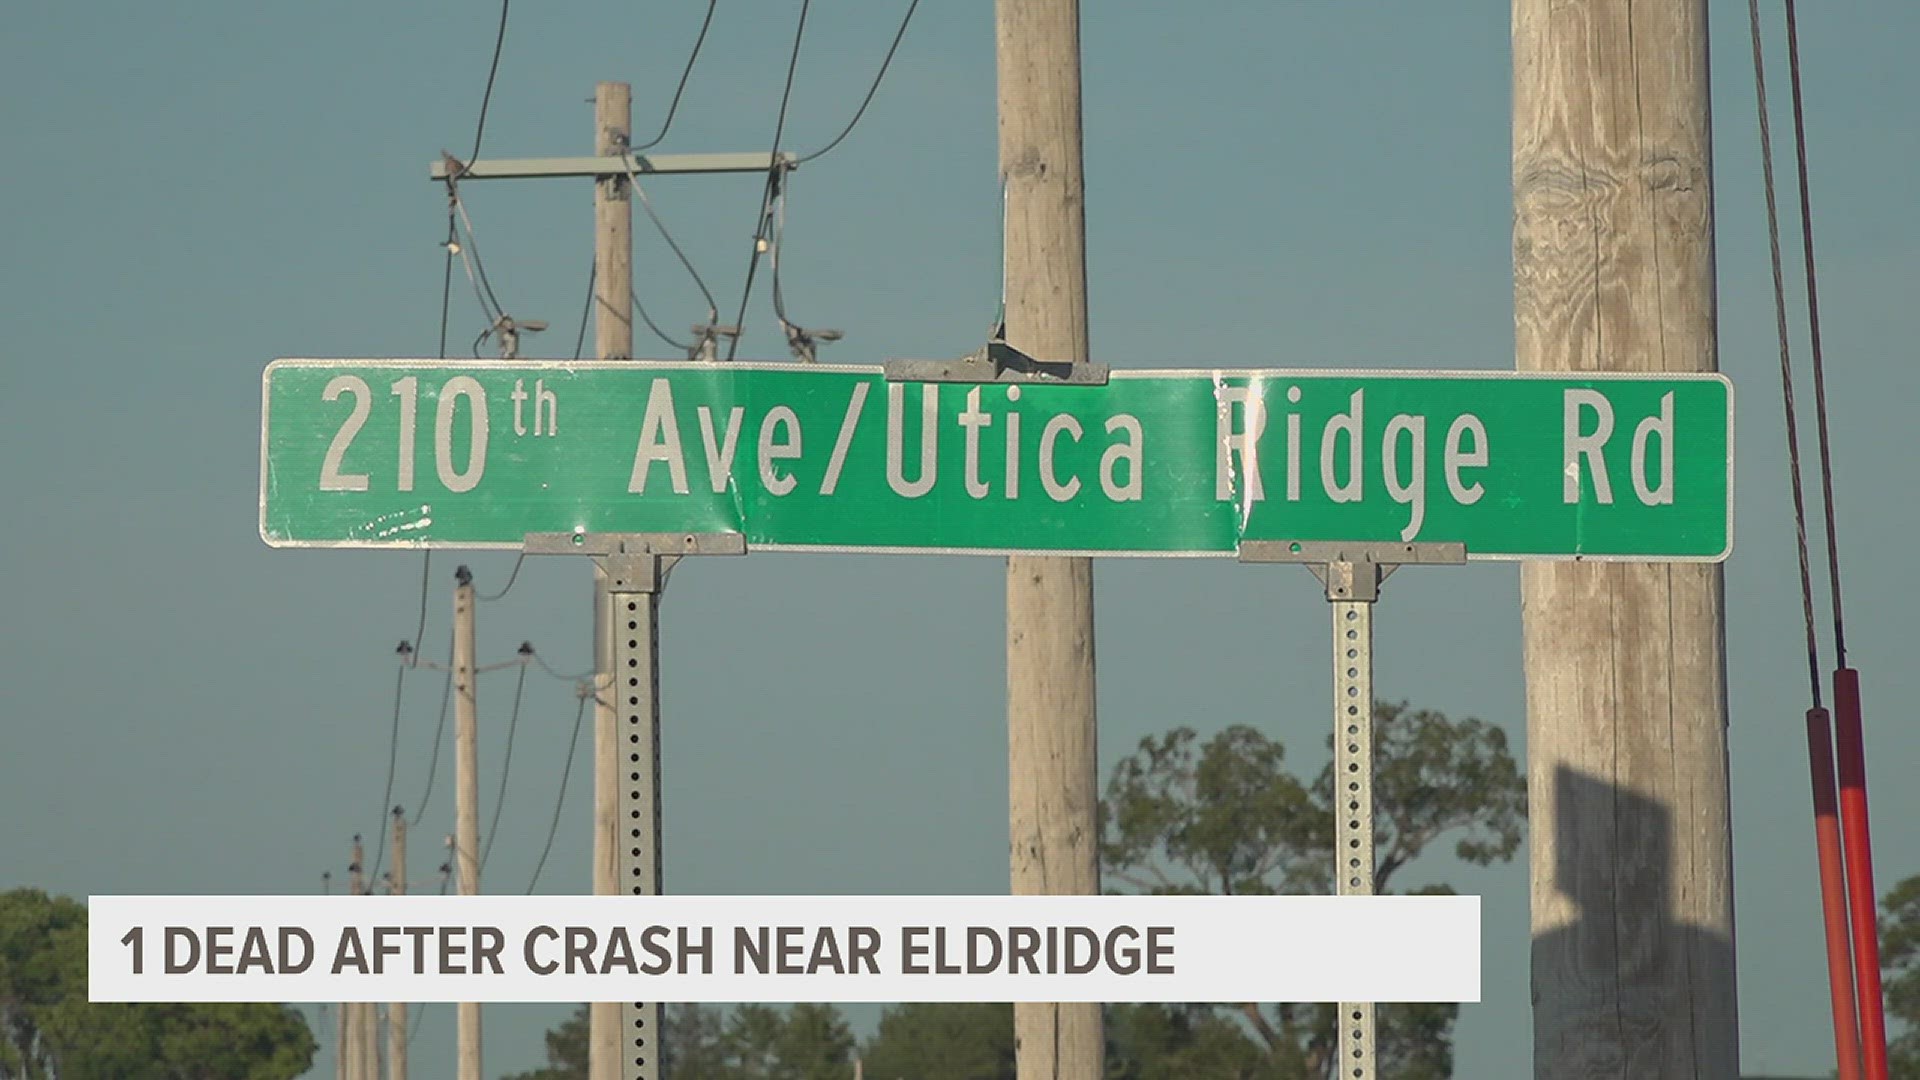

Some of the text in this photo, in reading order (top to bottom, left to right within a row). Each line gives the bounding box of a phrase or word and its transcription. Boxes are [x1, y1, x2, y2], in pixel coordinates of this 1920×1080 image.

[319, 375, 1675, 542] 210th Ave/Utica Ridge Rd
